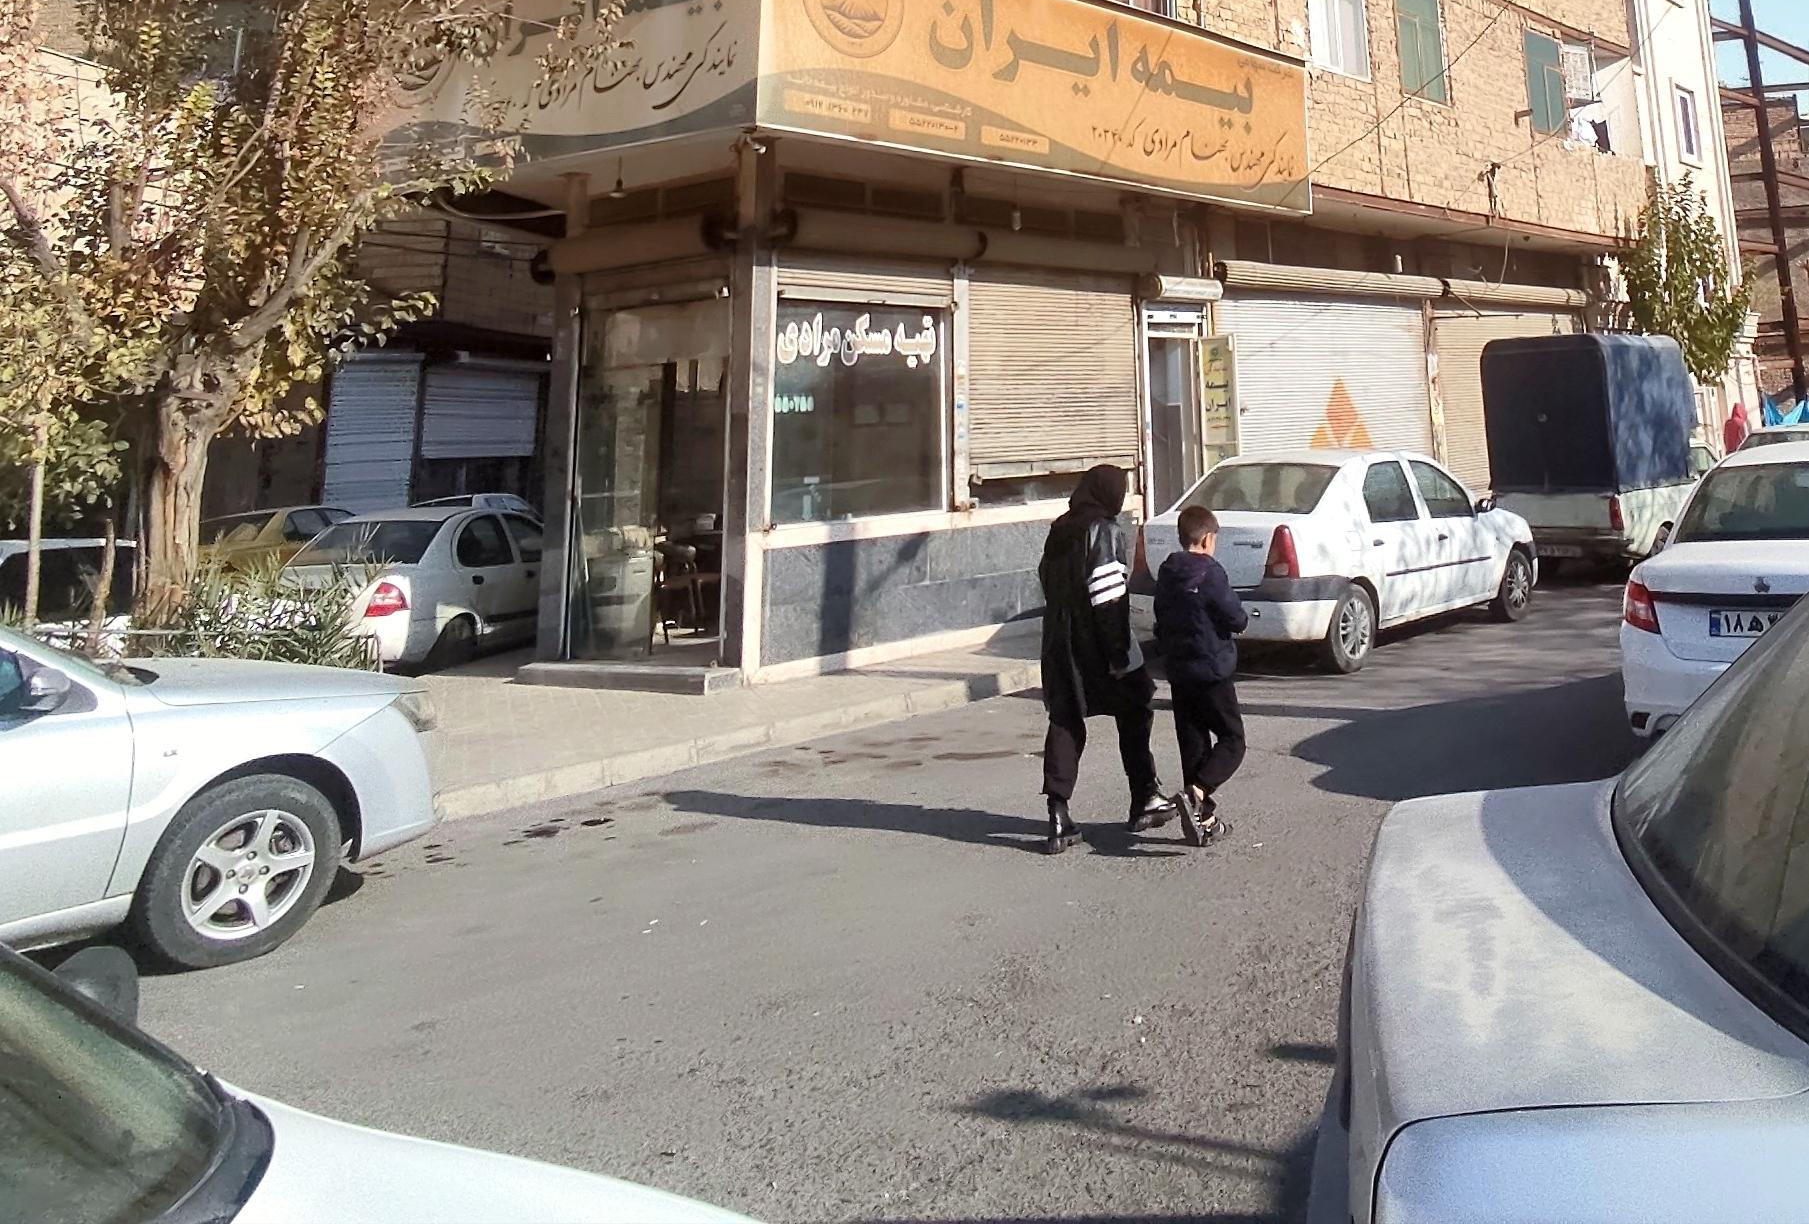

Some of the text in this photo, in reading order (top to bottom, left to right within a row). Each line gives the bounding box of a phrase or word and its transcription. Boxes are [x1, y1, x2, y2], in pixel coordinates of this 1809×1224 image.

[1131, 43, 1254, 135] بیمه
[1142, 127, 1178, 161] مرادی
[776, 312, 841, 367] مرادی
[841, 312, 893, 367] مسکن
[1205, 379, 1229, 393] بیمه
[1205, 396, 1231, 413] ایران
